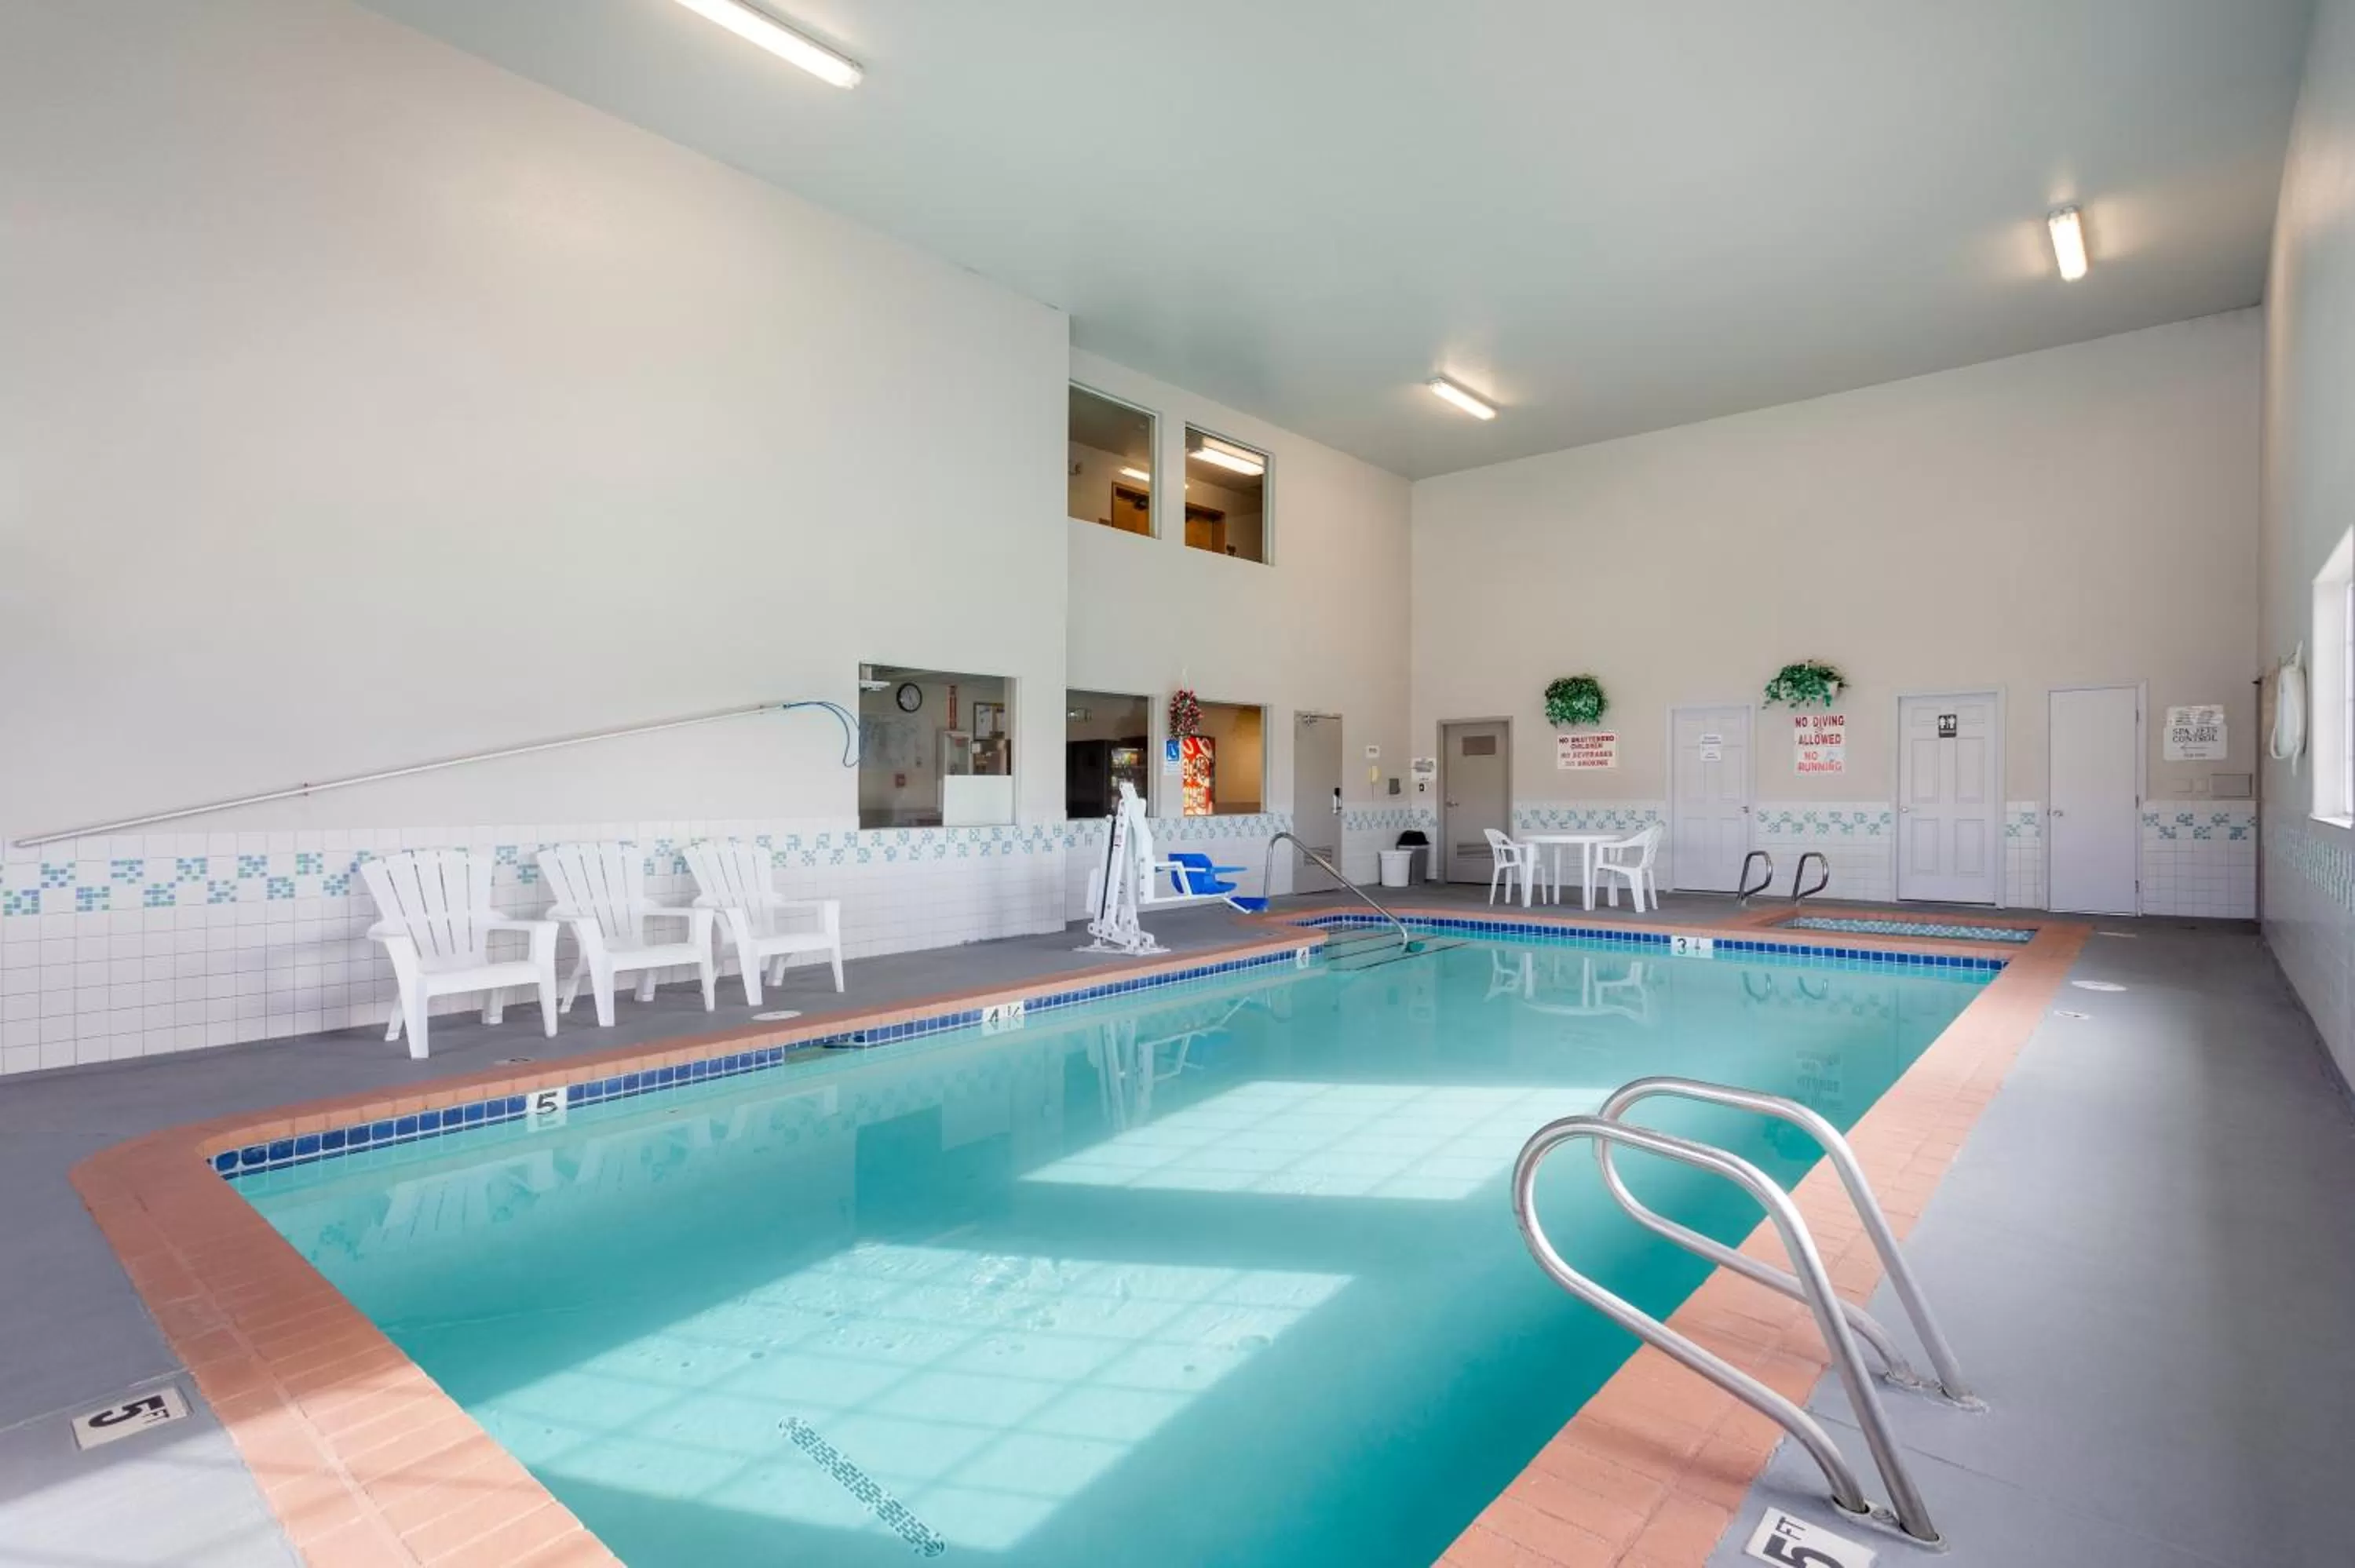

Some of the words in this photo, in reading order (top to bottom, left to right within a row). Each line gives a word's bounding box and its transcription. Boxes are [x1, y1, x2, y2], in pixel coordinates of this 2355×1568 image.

[1795, 717, 1808, 727] NO
[1813, 715, 1845, 727] DIVING
[1798, 734, 1842, 745] ALLOWED
[1804, 751, 1819, 760] NO
[1797, 761, 1843, 772] RUNNING
[535, 1091, 558, 1115] 5
[88, 1395, 165, 1428] 5
[140, 1408, 170, 1424] FT
[1775, 1515, 1806, 1541] FT
[1763, 1533, 1845, 1568] 5
